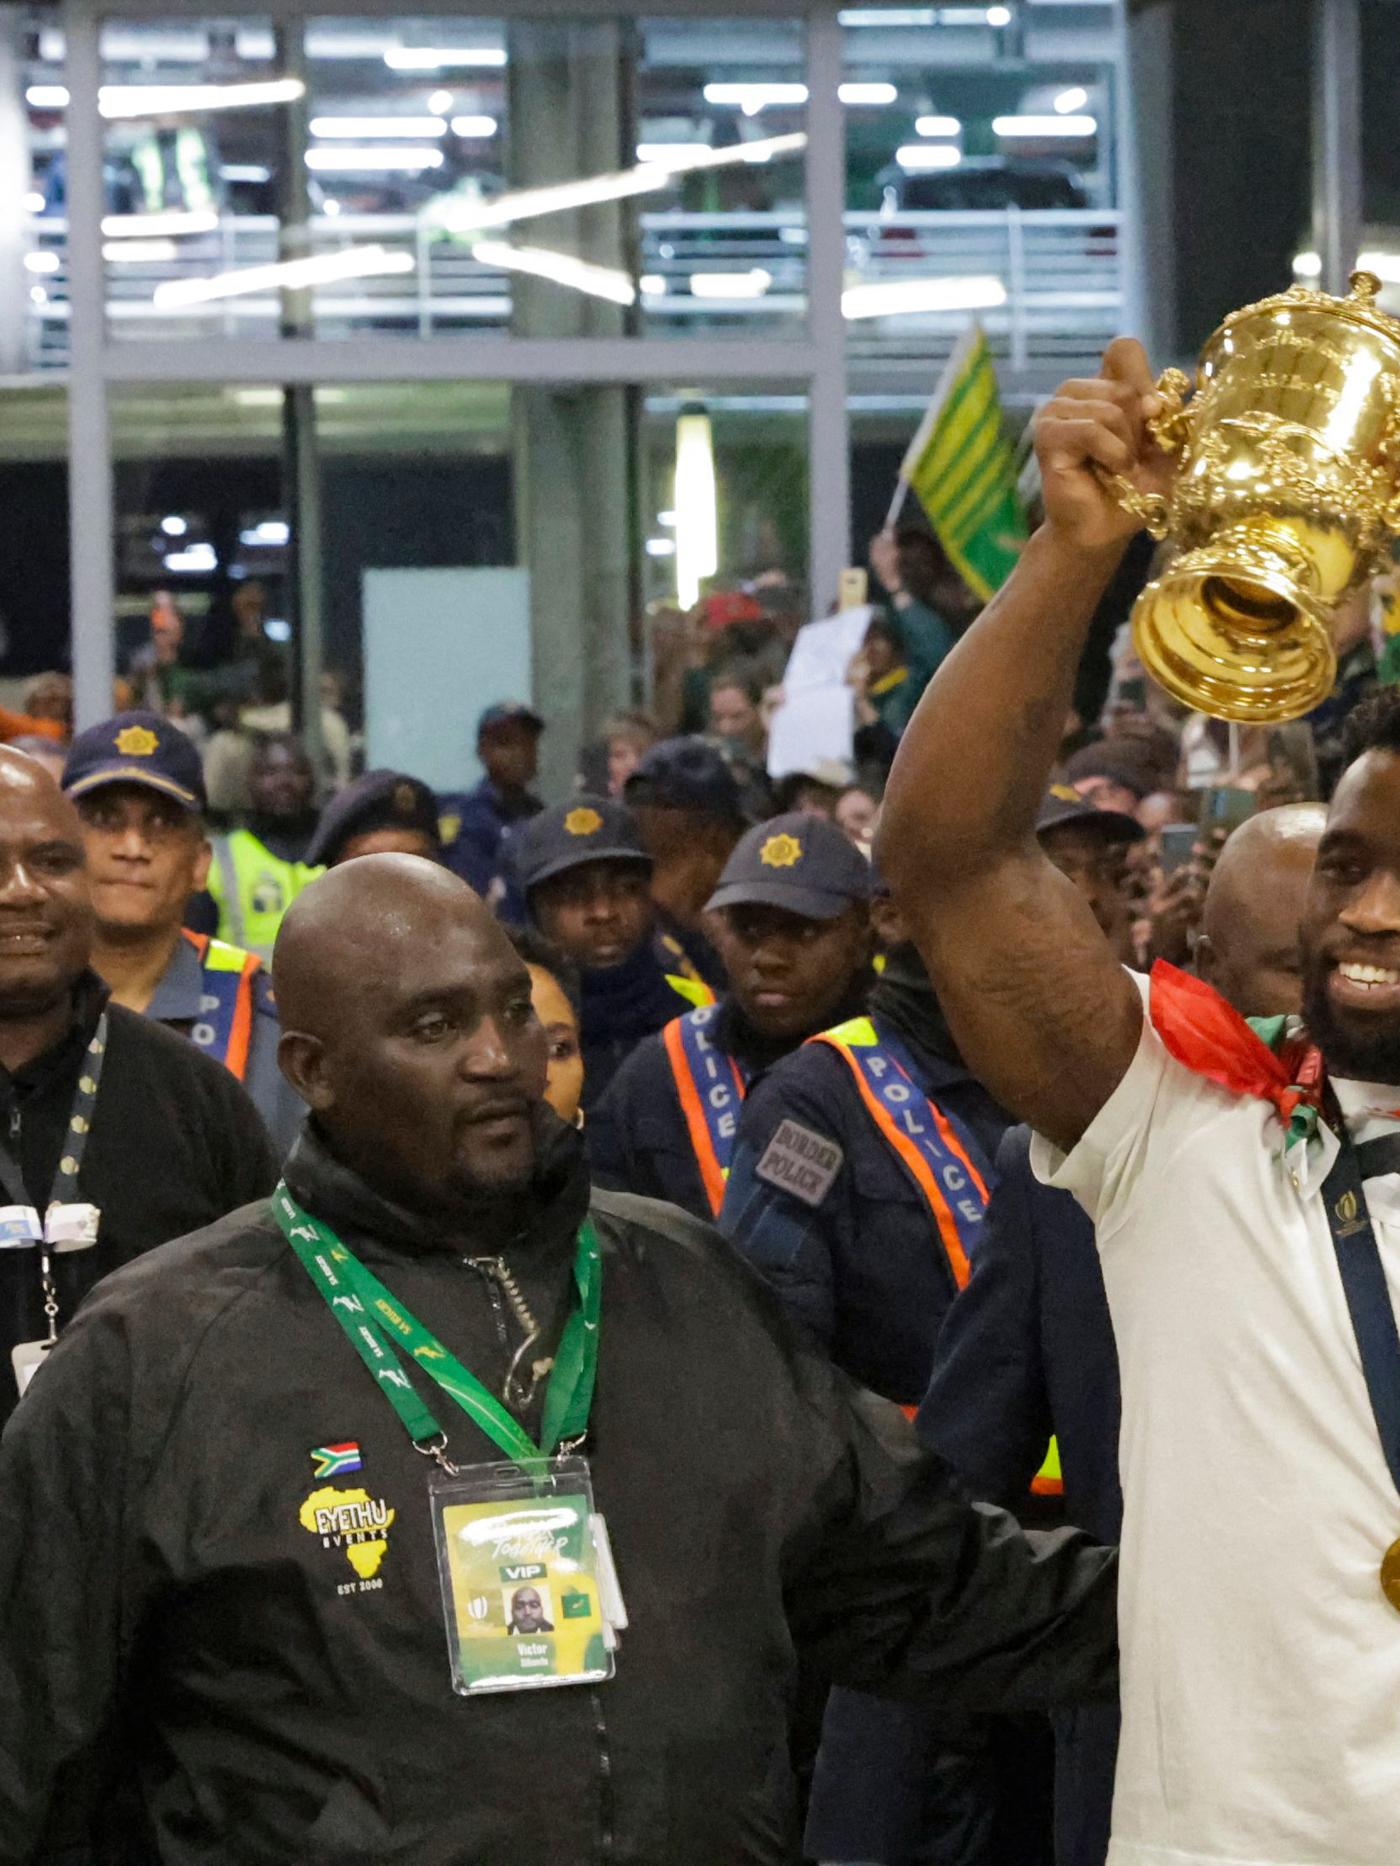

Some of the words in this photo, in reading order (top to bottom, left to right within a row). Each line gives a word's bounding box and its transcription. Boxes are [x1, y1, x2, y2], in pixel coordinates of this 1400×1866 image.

[690, 1008, 736, 1138] OLICE
[866, 1057, 982, 1222] POLICE
[762, 1151, 824, 1195] POLICE
[315, 1498, 387, 1534] EYETHU
[323, 1528, 388, 1549] EVENTS
[505, 1565, 541, 1580] VIP
